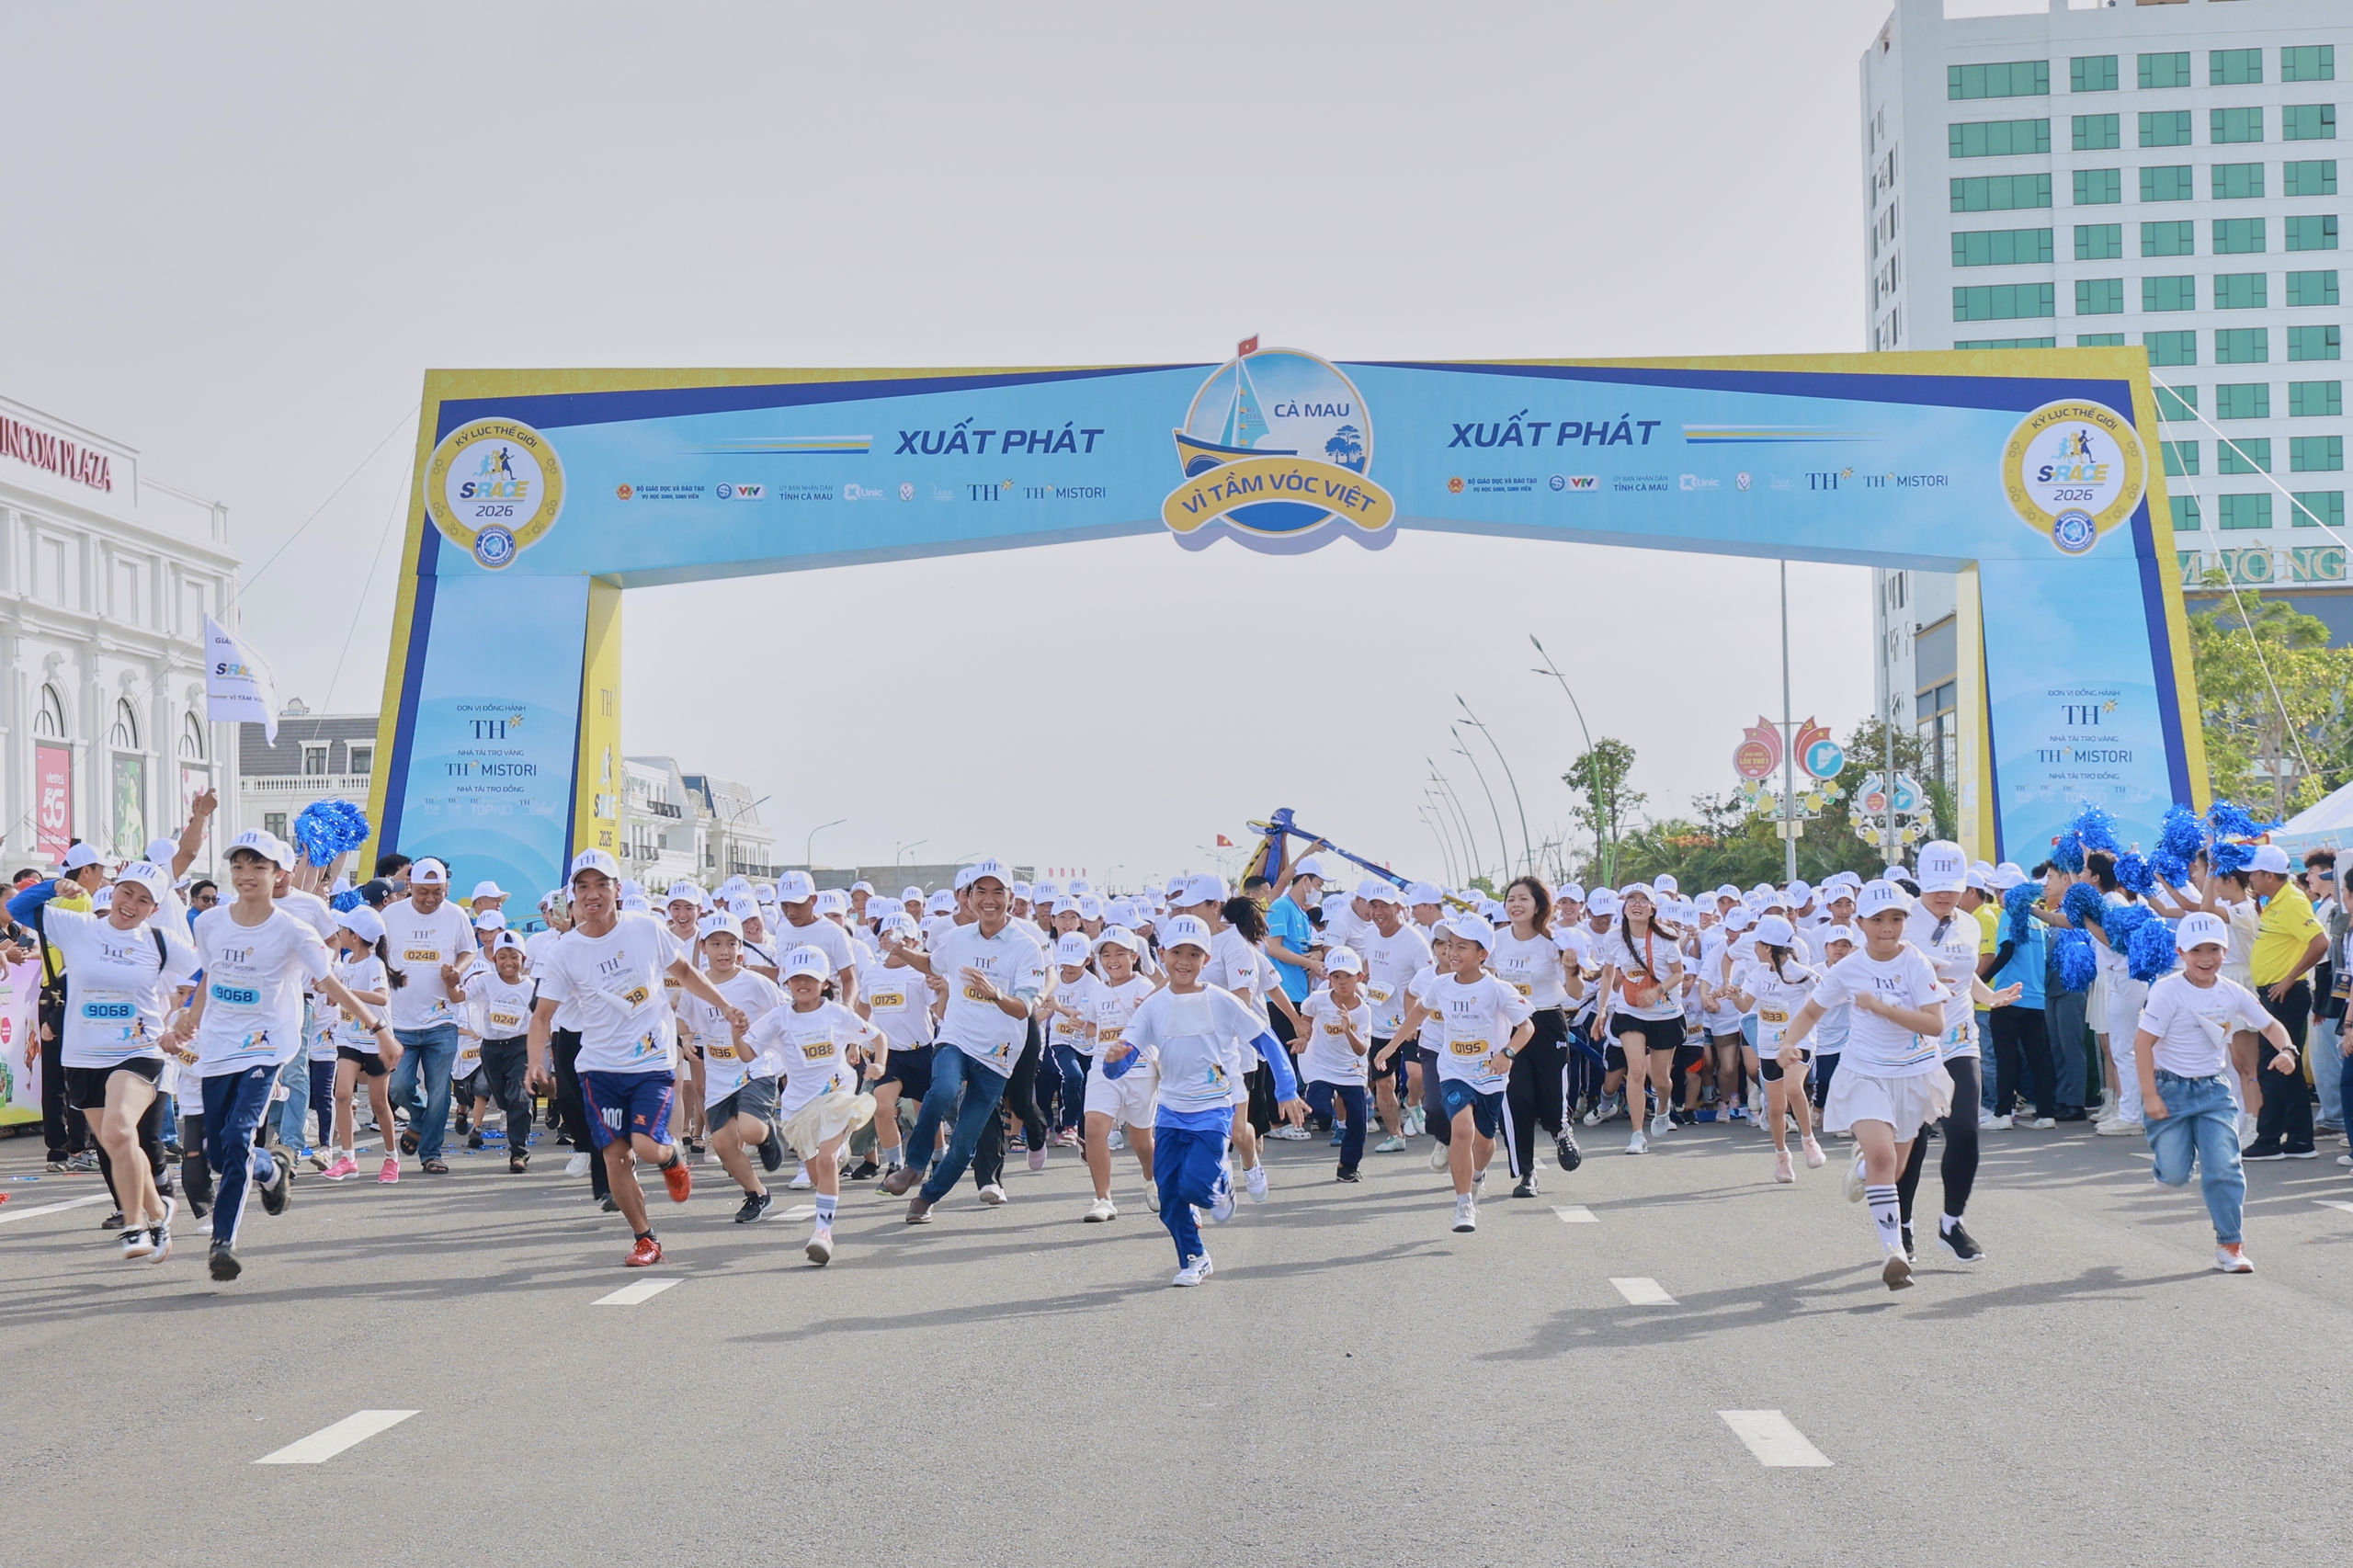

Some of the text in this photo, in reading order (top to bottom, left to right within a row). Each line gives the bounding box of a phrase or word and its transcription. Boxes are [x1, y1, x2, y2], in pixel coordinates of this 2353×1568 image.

[1274, 399, 1350, 417] CÀ MAU
[2049, 409, 2070, 420] LỤC
[2072, 407, 2097, 418] THẾ
[2096, 414, 2118, 430] GIỚI
[1447, 408, 1662, 449] XUẤT PHÁT
[472, 426, 492, 437] LỤC
[494, 426, 517, 437] THẾ
[517, 432, 538, 448] GIỚI
[893, 416, 1105, 454] XUẤT PHÁT
[0, 415, 114, 492] INCOM PLAZA
[1571, 478, 1594, 488] VTV
[1636, 483, 1647, 492] CÀ
[1648, 483, 1668, 492] MAU
[1697, 478, 1720, 488] Unic
[1805, 472, 1839, 491] TH
[1863, 475, 1948, 488] TH MISTORI
[738, 487, 761, 496] VTV
[801, 491, 813, 500] CÀ
[861, 487, 883, 497] Unic
[967, 484, 1000, 501] TH
[1023, 487, 1106, 499] TH MISTORI
[1181, 469, 1377, 514] VÌ TẦM VÓC VIỆT
[2053, 489, 2094, 500] 2026
[475, 506, 514, 517] 2026
[483, 703, 504, 711] ĐỒNG
[600, 688, 613, 717] TH
[2061, 705, 2100, 725] TH
[469, 720, 507, 739] TH
[2037, 750, 2132, 763] TH MISTORI
[445, 763, 537, 776] TH MISTORI
[2097, 771, 2120, 779] ĐỒNG
[503, 784, 524, 793] ĐỒNG
[42, 787, 65, 829] 5G
[578, 856, 596, 867] TH
[981, 863, 997, 872] TH
[1932, 860, 1952, 872] TH
[138, 864, 156, 880] TH
[1870, 888, 1893, 900] TH
[710, 917, 727, 926] TH
[1176, 922, 1196, 933] TH
[2188, 920, 2209, 932] TH
[222, 949, 244, 963] TH
[408, 951, 436, 960] 0248
[791, 954, 809, 965] TH
[597, 958, 618, 974] TH
[973, 956, 990, 969] TH
[1507, 958, 1525, 968] TH
[217, 987, 254, 1003] 9068
[875, 994, 897, 1005] 0175
[88, 1006, 129, 1017] 9068
[1451, 1001, 1469, 1012] TH
[1762, 1013, 1783, 1021] 0133
[710, 1047, 731, 1057] 0136
[1455, 1042, 1481, 1054] 0195
[601, 1107, 623, 1131] 100
